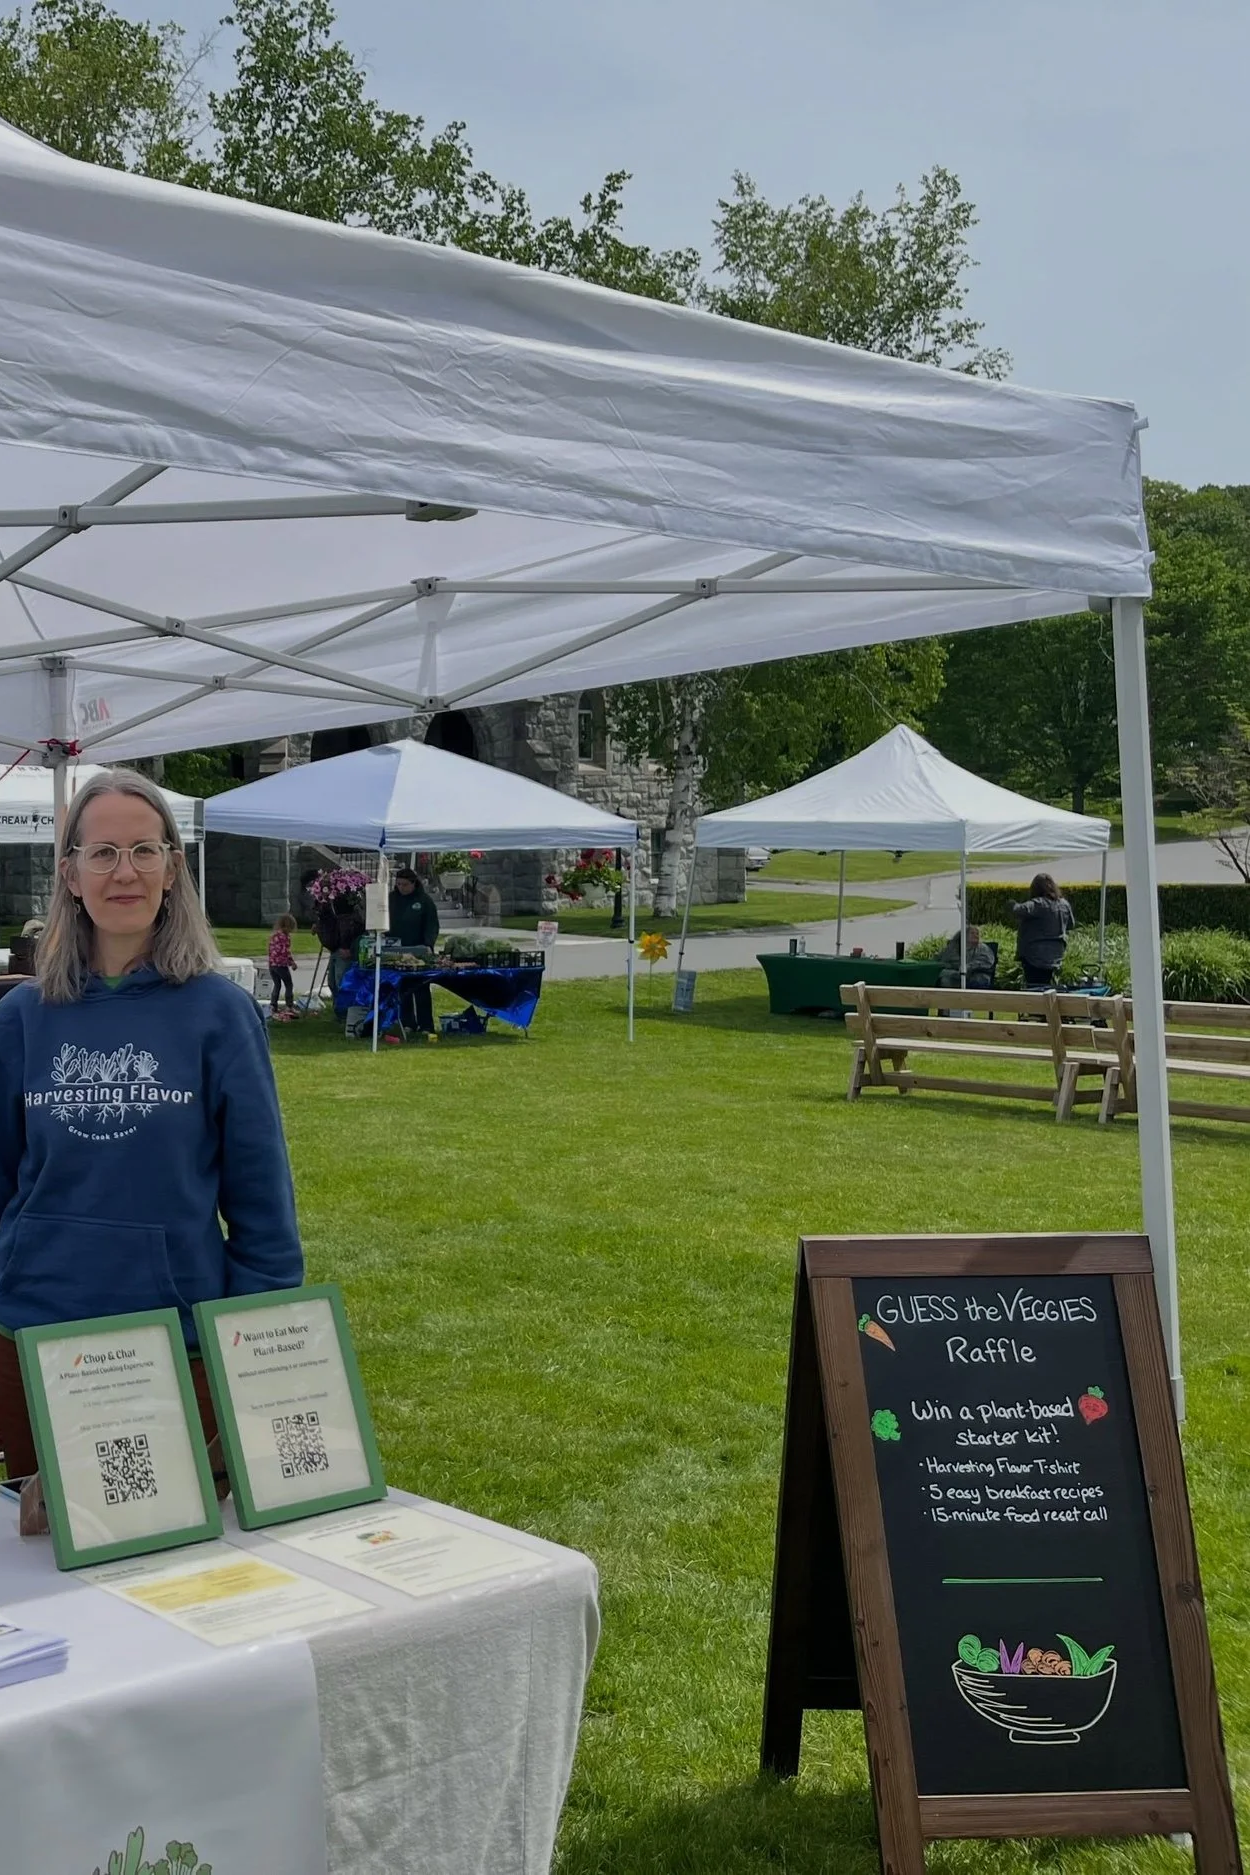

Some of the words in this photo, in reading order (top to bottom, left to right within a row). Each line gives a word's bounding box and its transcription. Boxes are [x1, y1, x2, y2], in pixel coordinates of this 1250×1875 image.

[24, 1084, 123, 1107] Harvesting
[130, 1084, 194, 1104] Flavor
[68, 1125, 89, 1139] Grow
[113, 1125, 137, 1139] Savor
[876, 1295, 958, 1324] GUESS
[964, 1297, 1001, 1321] the
[997, 1288, 1097, 1322] VEGGIES
[243, 1332, 264, 1342] Want
[266, 1330, 274, 1339] to
[274, 1328, 287, 1337] Eat
[287, 1325, 309, 1334] More
[83, 1354, 106, 1364] Chop
[107, 1351, 115, 1360] &
[116, 1349, 136, 1359] Chat
[253, 1340, 305, 1356] Plant-Based?
[946, 1336, 1037, 1363] Raffle
[911, 1400, 953, 1421] Win
[959, 1405, 974, 1420] a
[976, 1396, 1075, 1424] plant-based
[956, 1428, 1019, 1446] starter
[1024, 1423, 1060, 1444] kit!
[926, 1456, 995, 1477] Harvesting
[996, 1457, 1033, 1474] Flavor
[1033, 1458, 1081, 1475] T-shirt
[929, 1484, 943, 1500] 5
[946, 1490, 981, 1505] easy
[985, 1484, 1051, 1500] breakfast
[1053, 1482, 1104, 1503] recipes
[931, 1507, 1000, 1522] 15-minute
[1003, 1506, 1040, 1523] food
[1043, 1507, 1081, 1522] reset
[1084, 1506, 1108, 1522] call
